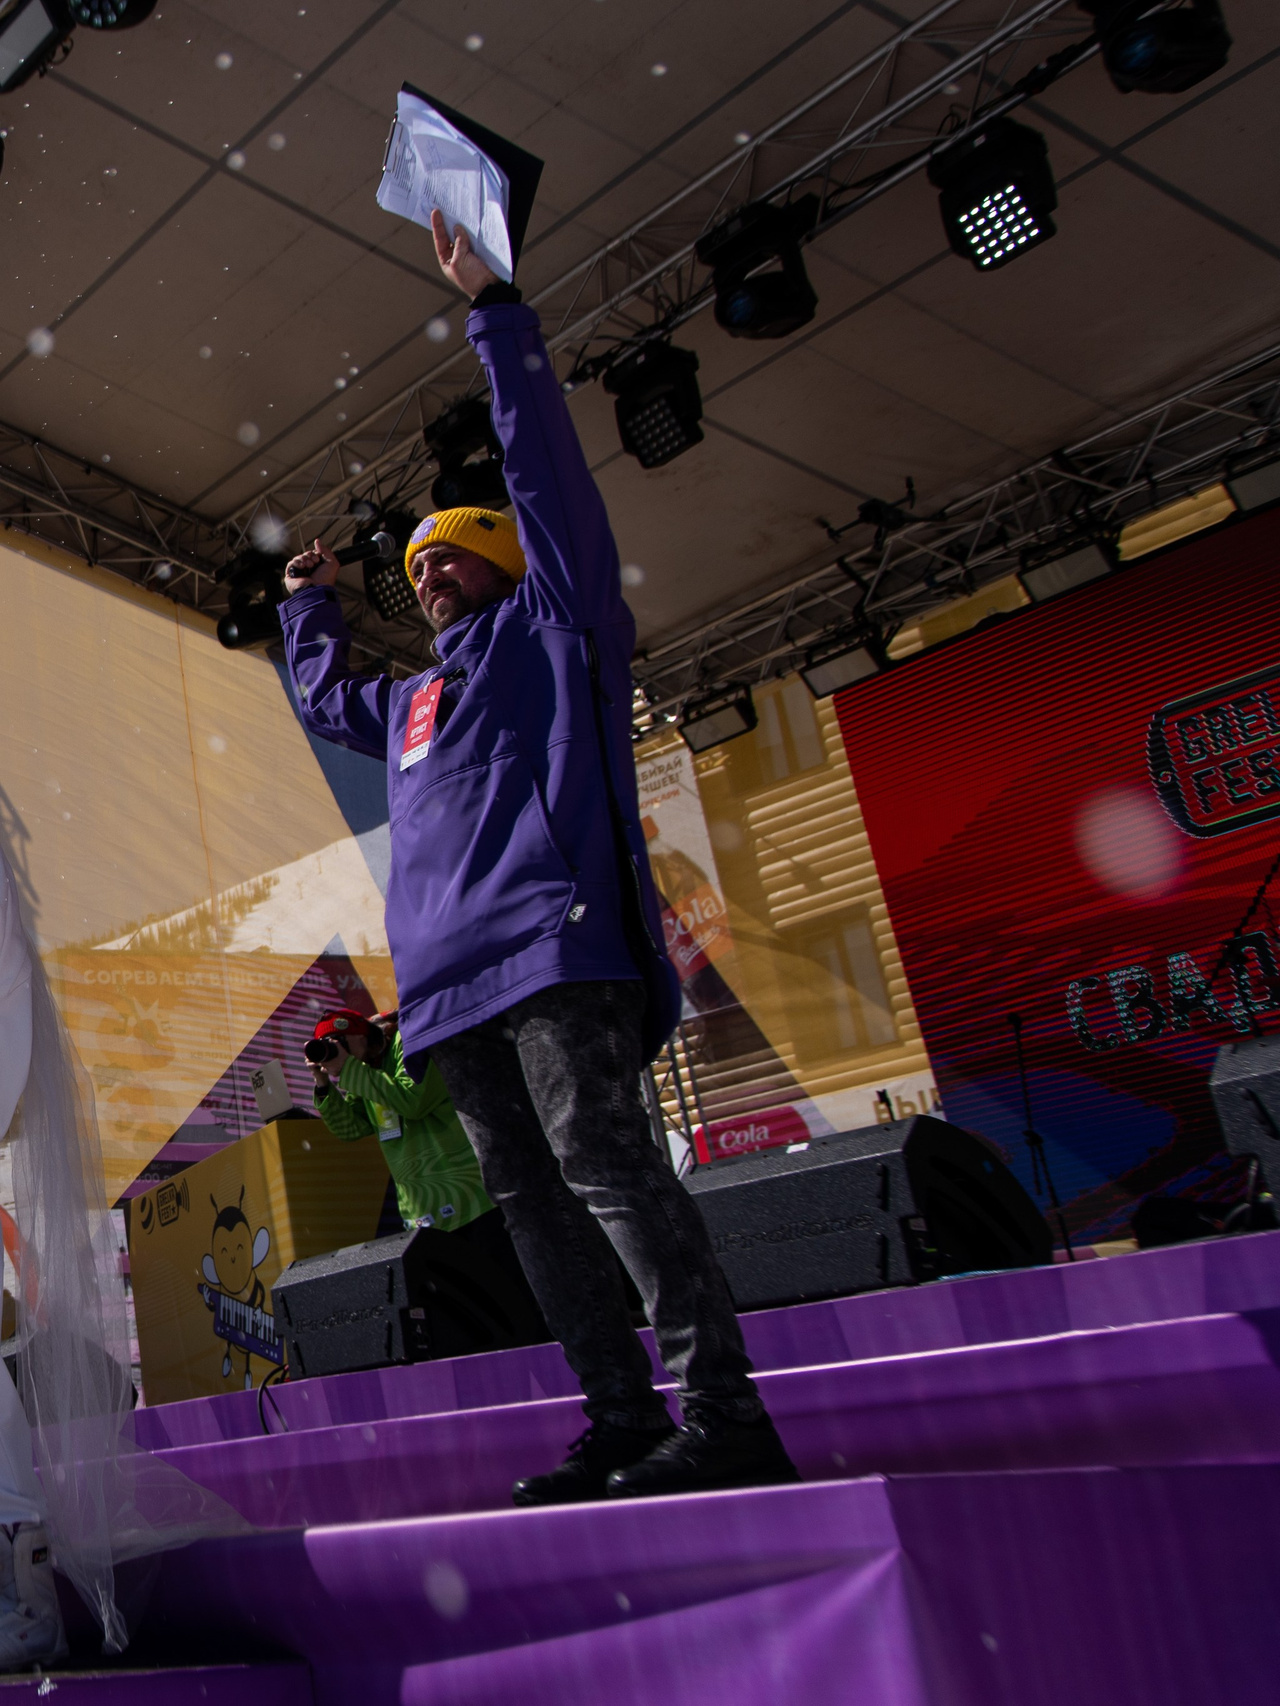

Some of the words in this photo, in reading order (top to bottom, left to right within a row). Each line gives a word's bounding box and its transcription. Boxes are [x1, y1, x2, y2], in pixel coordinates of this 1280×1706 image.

[637, 755, 683, 783] БИРАЙ
[661, 896, 720, 948] Cola
[83, 969, 205, 987] СОГРЕВАЕМ
[719, 1123, 770, 1150] Cola
